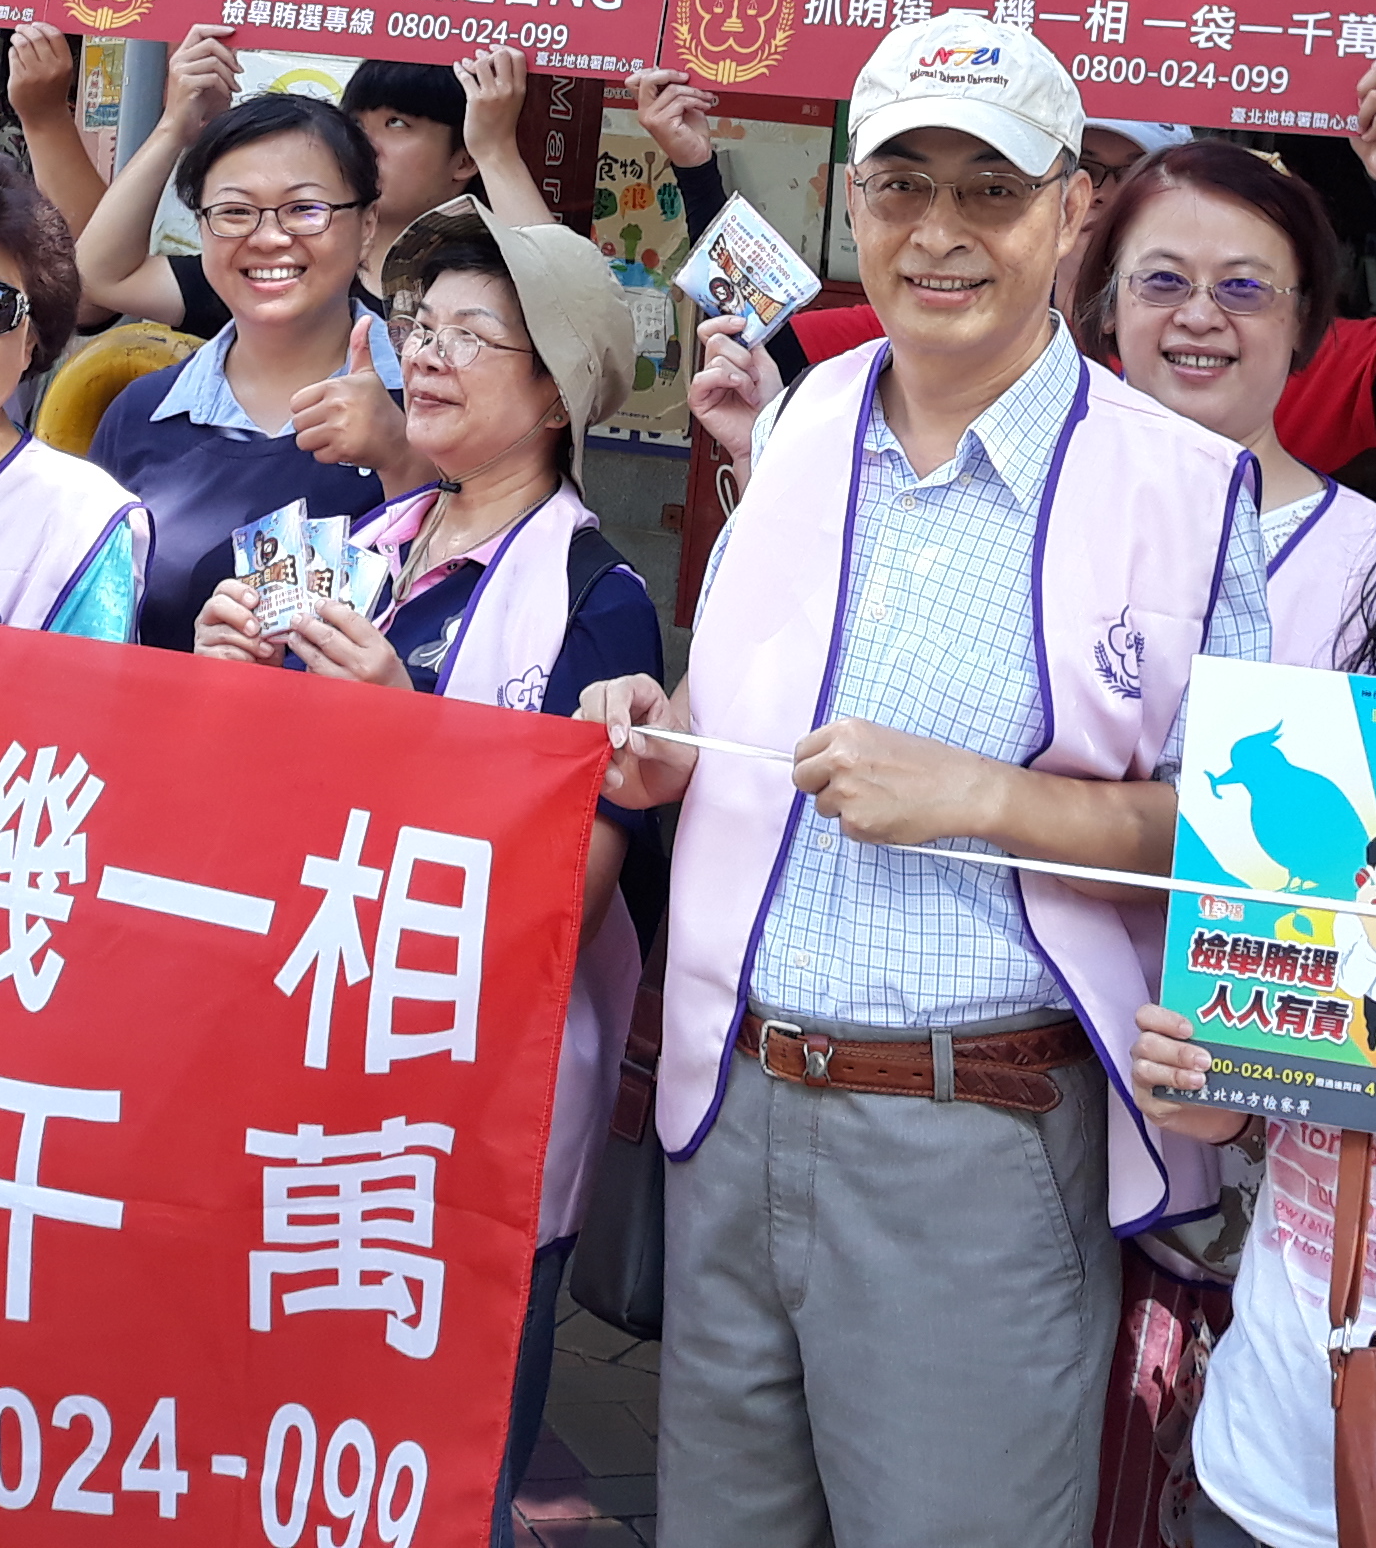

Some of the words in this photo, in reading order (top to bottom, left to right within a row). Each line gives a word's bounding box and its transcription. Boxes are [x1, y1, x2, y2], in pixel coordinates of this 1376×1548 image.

[387, 12, 569, 50] 0800-024-099
[1071, 53, 1290, 94] 0800-024-099
[543, 75, 577, 224] Mar
[598, 151, 644, 181] 食物
[1187, 927, 1340, 991] 檢舉賄選
[1197, 980, 1353, 1045] 人人有責
[1211, 1057, 1315, 1088] 00-024-099
[1363, 1081, 1376, 1098] 4
